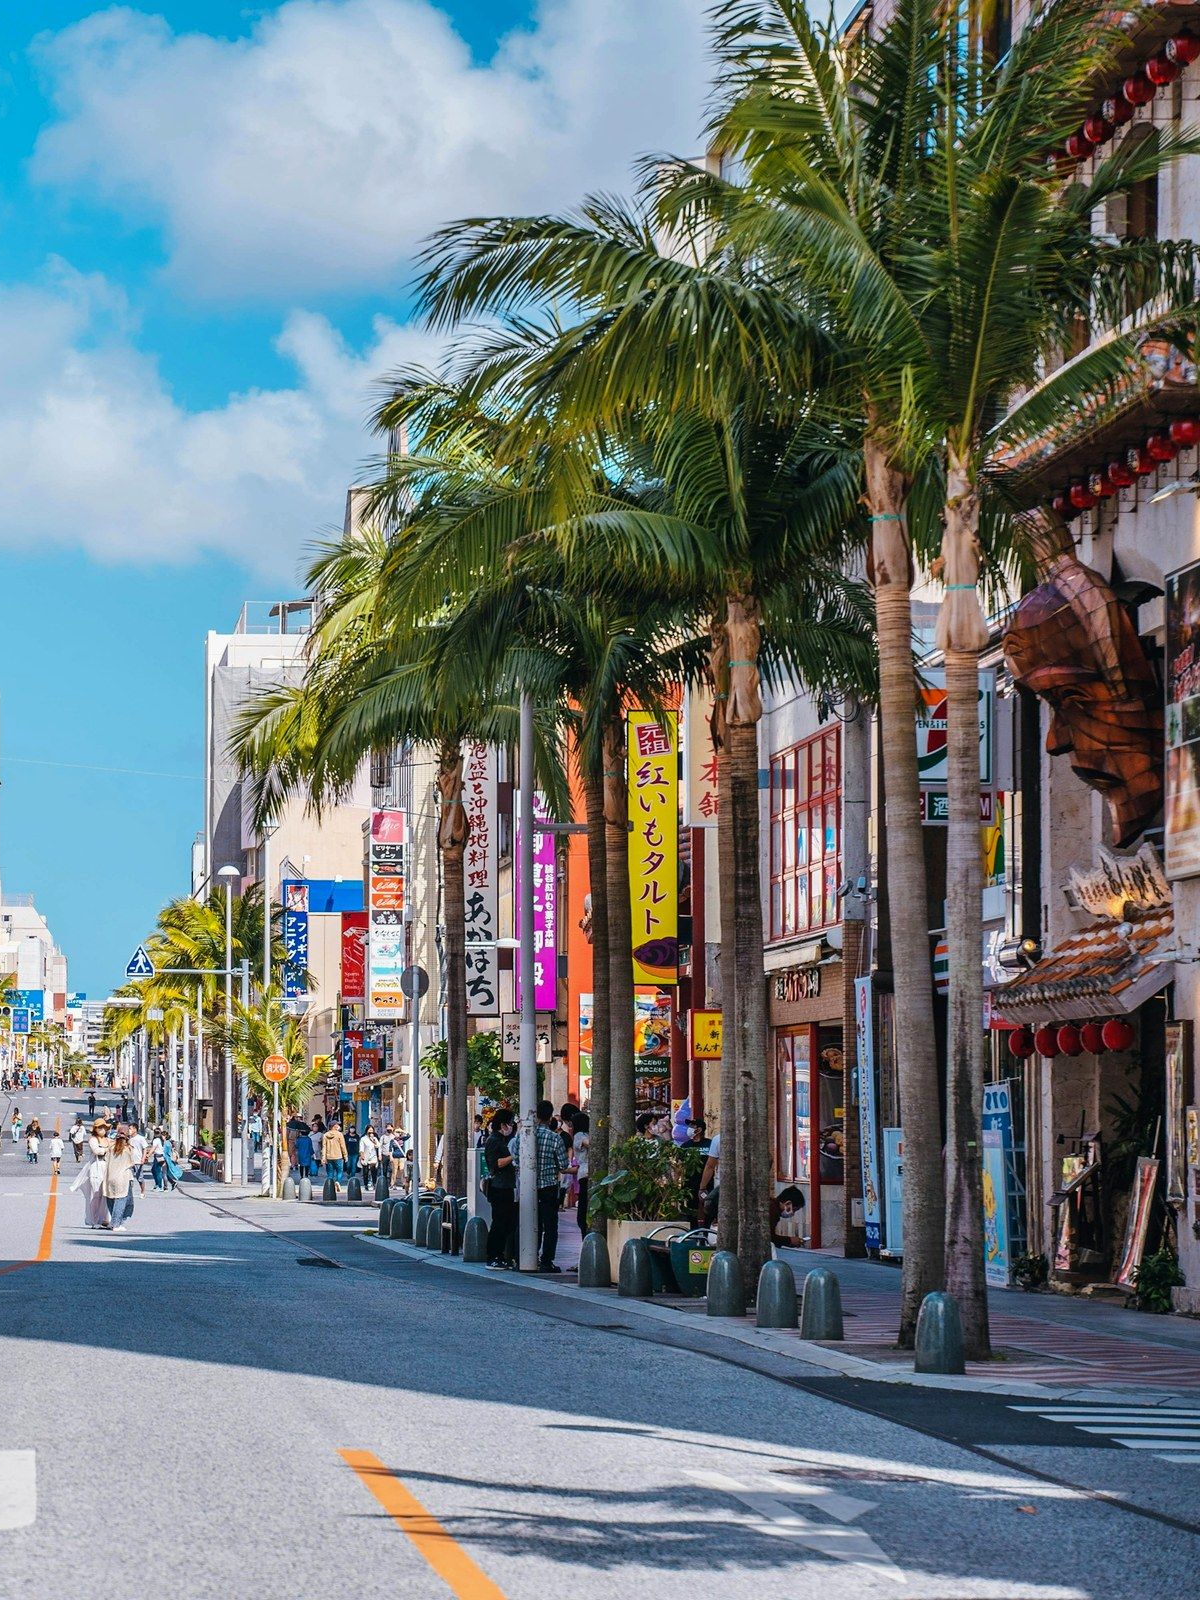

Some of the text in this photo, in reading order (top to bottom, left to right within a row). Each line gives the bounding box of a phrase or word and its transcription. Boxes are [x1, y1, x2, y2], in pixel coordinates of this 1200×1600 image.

[639, 724, 670, 756] 元祖
[634, 761, 671, 935] 紅いもタルト
[464, 891, 495, 1006] あかはち
[504, 1031, 549, 1045] あち
[695, 1042, 722, 1052] ちんす
